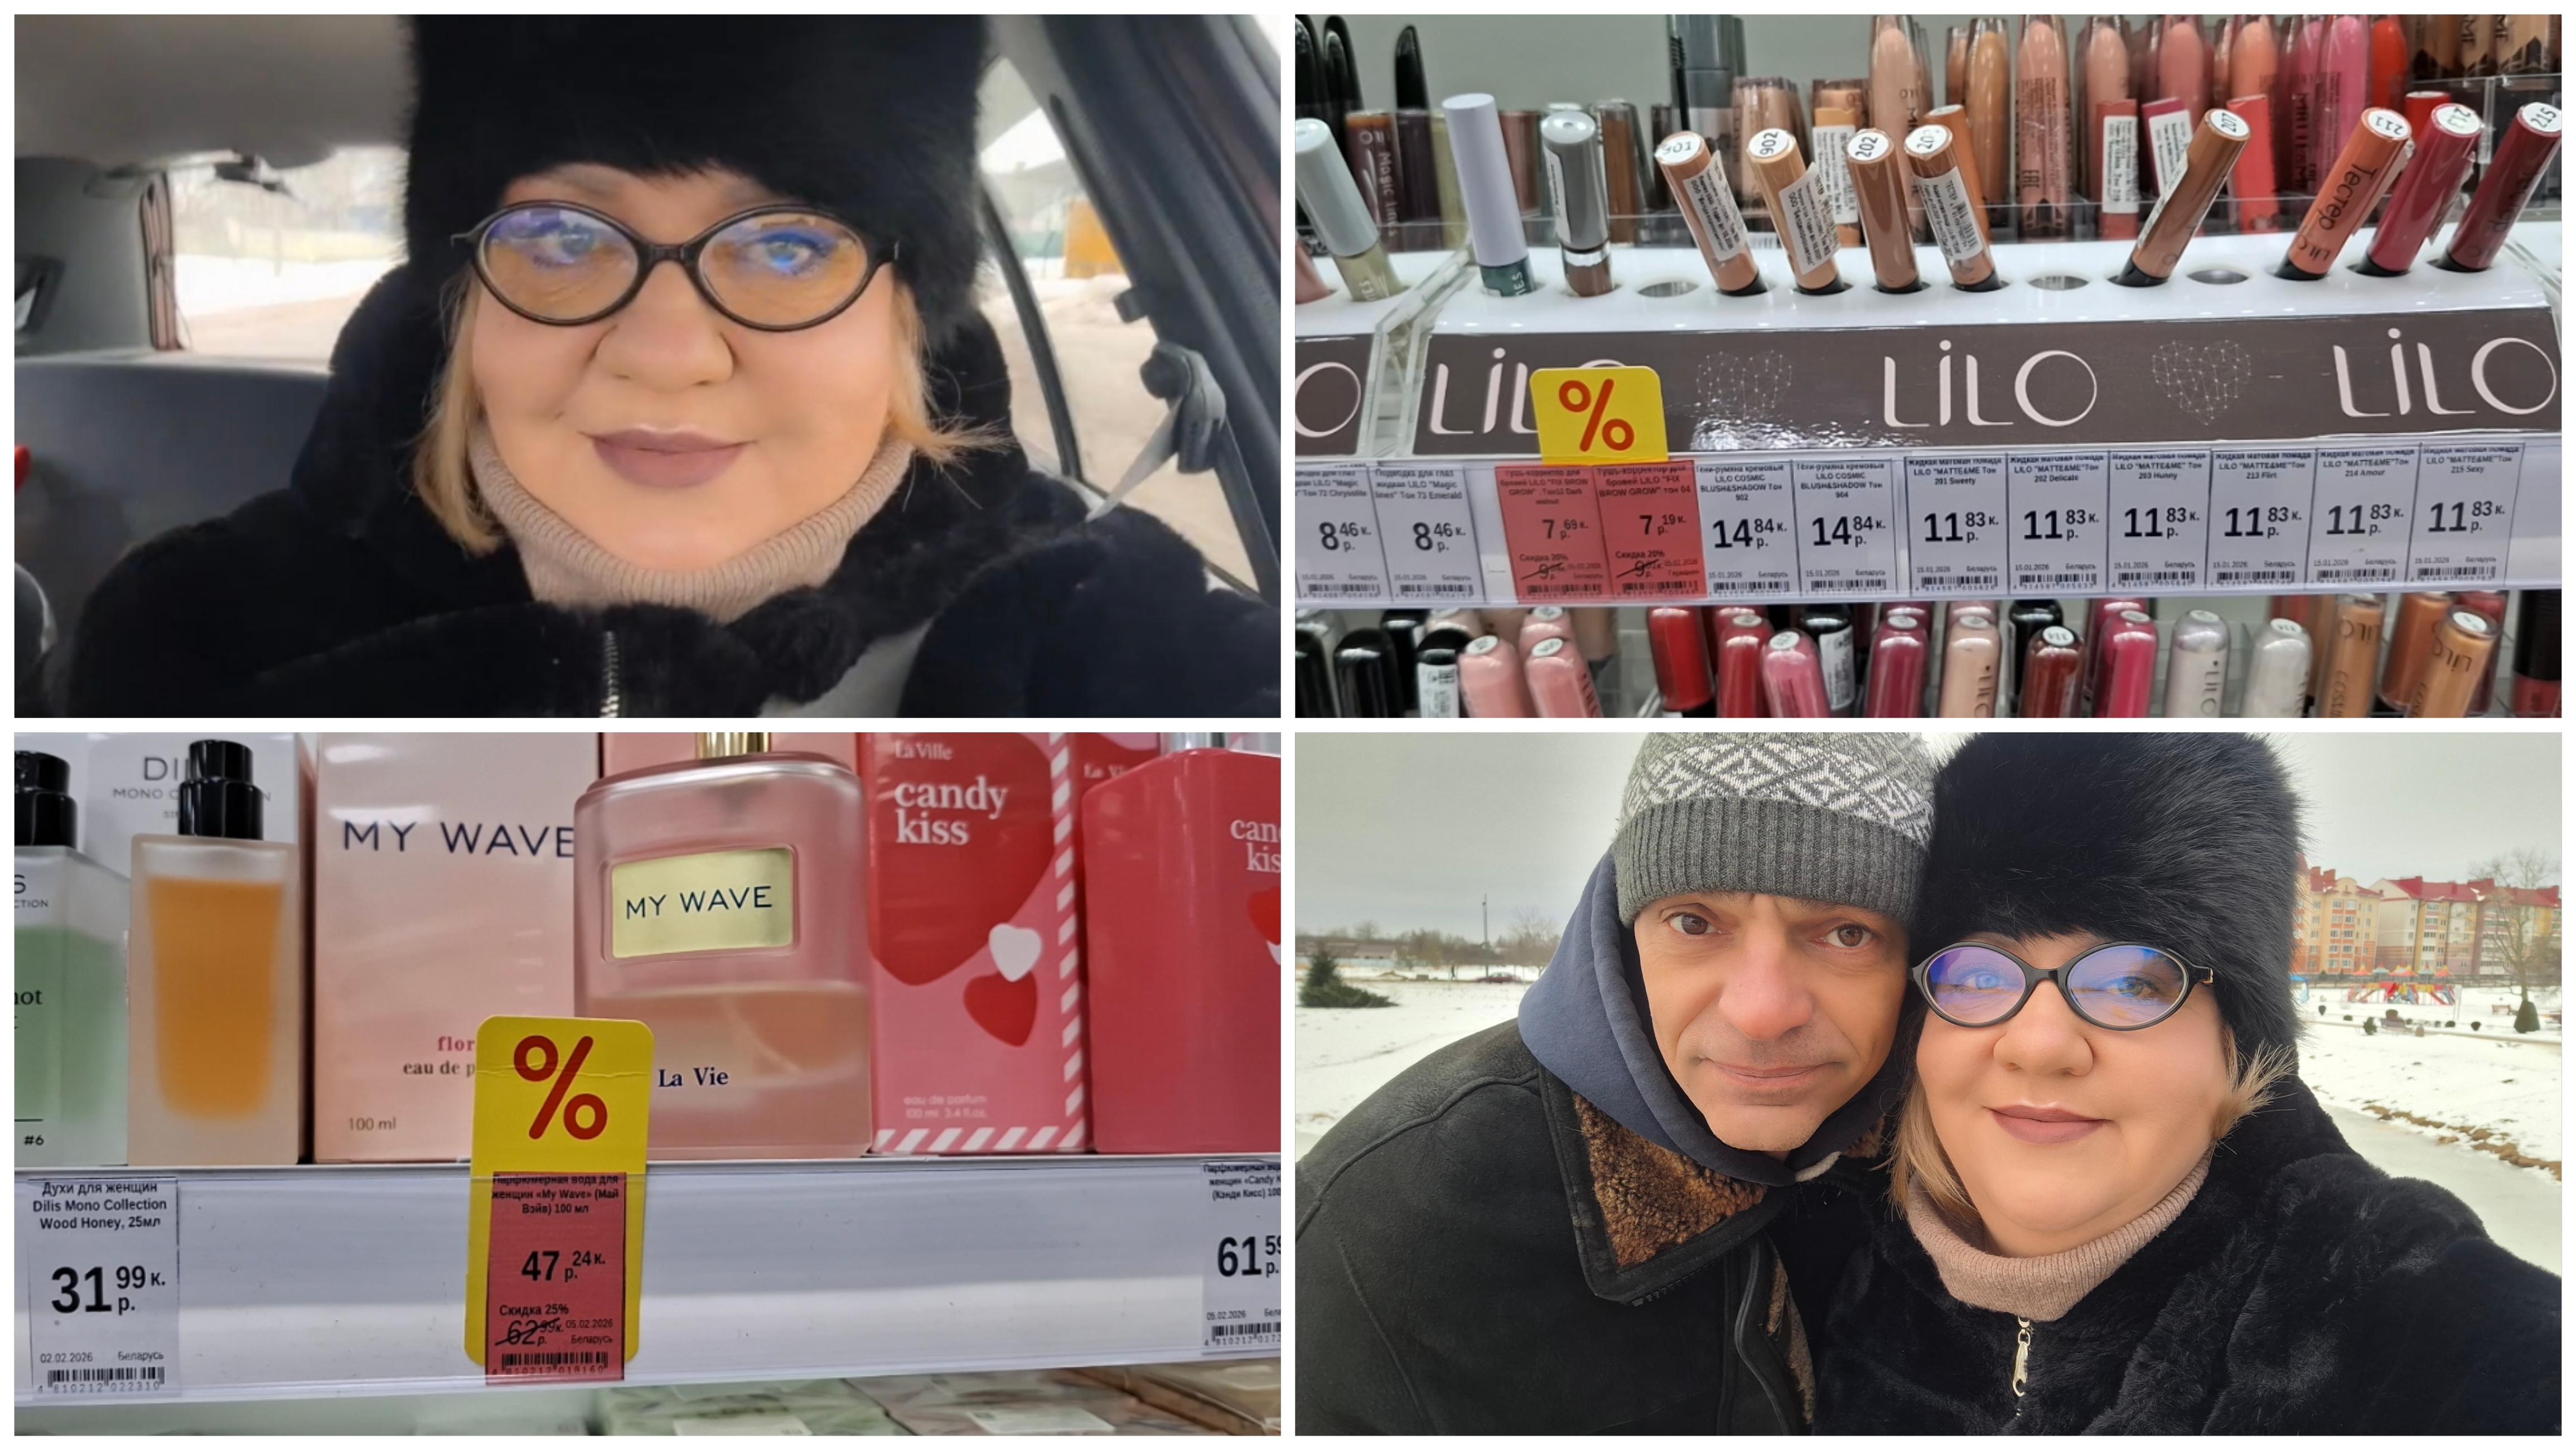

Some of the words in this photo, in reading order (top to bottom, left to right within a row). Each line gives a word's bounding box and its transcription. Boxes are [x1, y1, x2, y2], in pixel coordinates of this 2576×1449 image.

[1760, 132, 1778, 154] 902
[1855, 137, 1878, 158] 202
[1639, 514, 1652, 535] 7
[1924, 513, 1963, 542] 11
[1965, 512, 1986, 527] 83
[2024, 510, 2062, 539] 11
[2065, 509, 2086, 525] 83
[2124, 508, 2163, 537] 11
[2166, 508, 2187, 523] 83
[2224, 508, 2264, 537] 11
[2268, 507, 2288, 523] 83
[2326, 505, 2366, 534] 11
[2370, 504, 2391, 520] 83
[2428, 502, 2468, 533] 11
[2472, 501, 2492, 517] 83
[1319, 521, 1340, 550] 8
[1340, 522, 1359, 537] 46
[1413, 521, 1433, 550] 8
[1433, 522, 1453, 537] 46
[1542, 519, 1555, 539] 7
[1713, 518, 1753, 548] 14
[1754, 518, 1774, 533] 84
[1812, 516, 1852, 546] 14
[1853, 516, 1873, 531] 84
[916, 742, 953, 761] Ville
[113, 788, 163, 800] MONO
[894, 775, 1008, 820] candy
[895, 808, 970, 846] kiss
[343, 820, 418, 853] MY
[440, 821, 574, 858] WAVE
[625, 893, 668, 921] MY
[679, 885, 773, 914] WAVE
[403, 1063, 433, 1075] eau
[439, 1060, 460, 1075] de
[658, 1068, 683, 1088] La
[693, 1066, 729, 1087] Vie
[348, 1118, 375, 1132] 100
[378, 1117, 397, 1132] ml
[23, 1134, 45, 1147] #6
[42, 1181, 75, 1197] Духи
[78, 1182, 102, 1195] для
[105, 1181, 157, 1195] женщин
[572, 1176, 597, 1186] вода
[599, 1175, 618, 1186] для
[492, 1190, 533, 1200] женщин
[595, 1188, 619, 1201] (Май
[32, 1200, 61, 1213] Dilis
[65, 1200, 100, 1212] Mono
[104, 1198, 167, 1211] Collection
[522, 1204, 552, 1215] Вэйв)
[554, 1204, 572, 1214] 100
[574, 1205, 589, 1214] мл
[40, 1218, 78, 1230] Wood
[80, 1218, 125, 1231] Honey,
[521, 1250, 560, 1281] 47
[572, 1250, 591, 1267] 24
[1217, 1236, 1262, 1278] 61
[51, 1266, 113, 1314] 31
[116, 1265, 146, 1289] 99
[499, 1305, 542, 1317] Скидка
[544, 1304, 569, 1315] 25%
[1206, 1311, 1246, 1321] 05.02.2026
[566, 1319, 613, 1329] 05.02.2026
[571, 1335, 613, 1345] Беларусь
[40, 1352, 93, 1364] 02.02.2026
[118, 1350, 164, 1362] Беларусь
